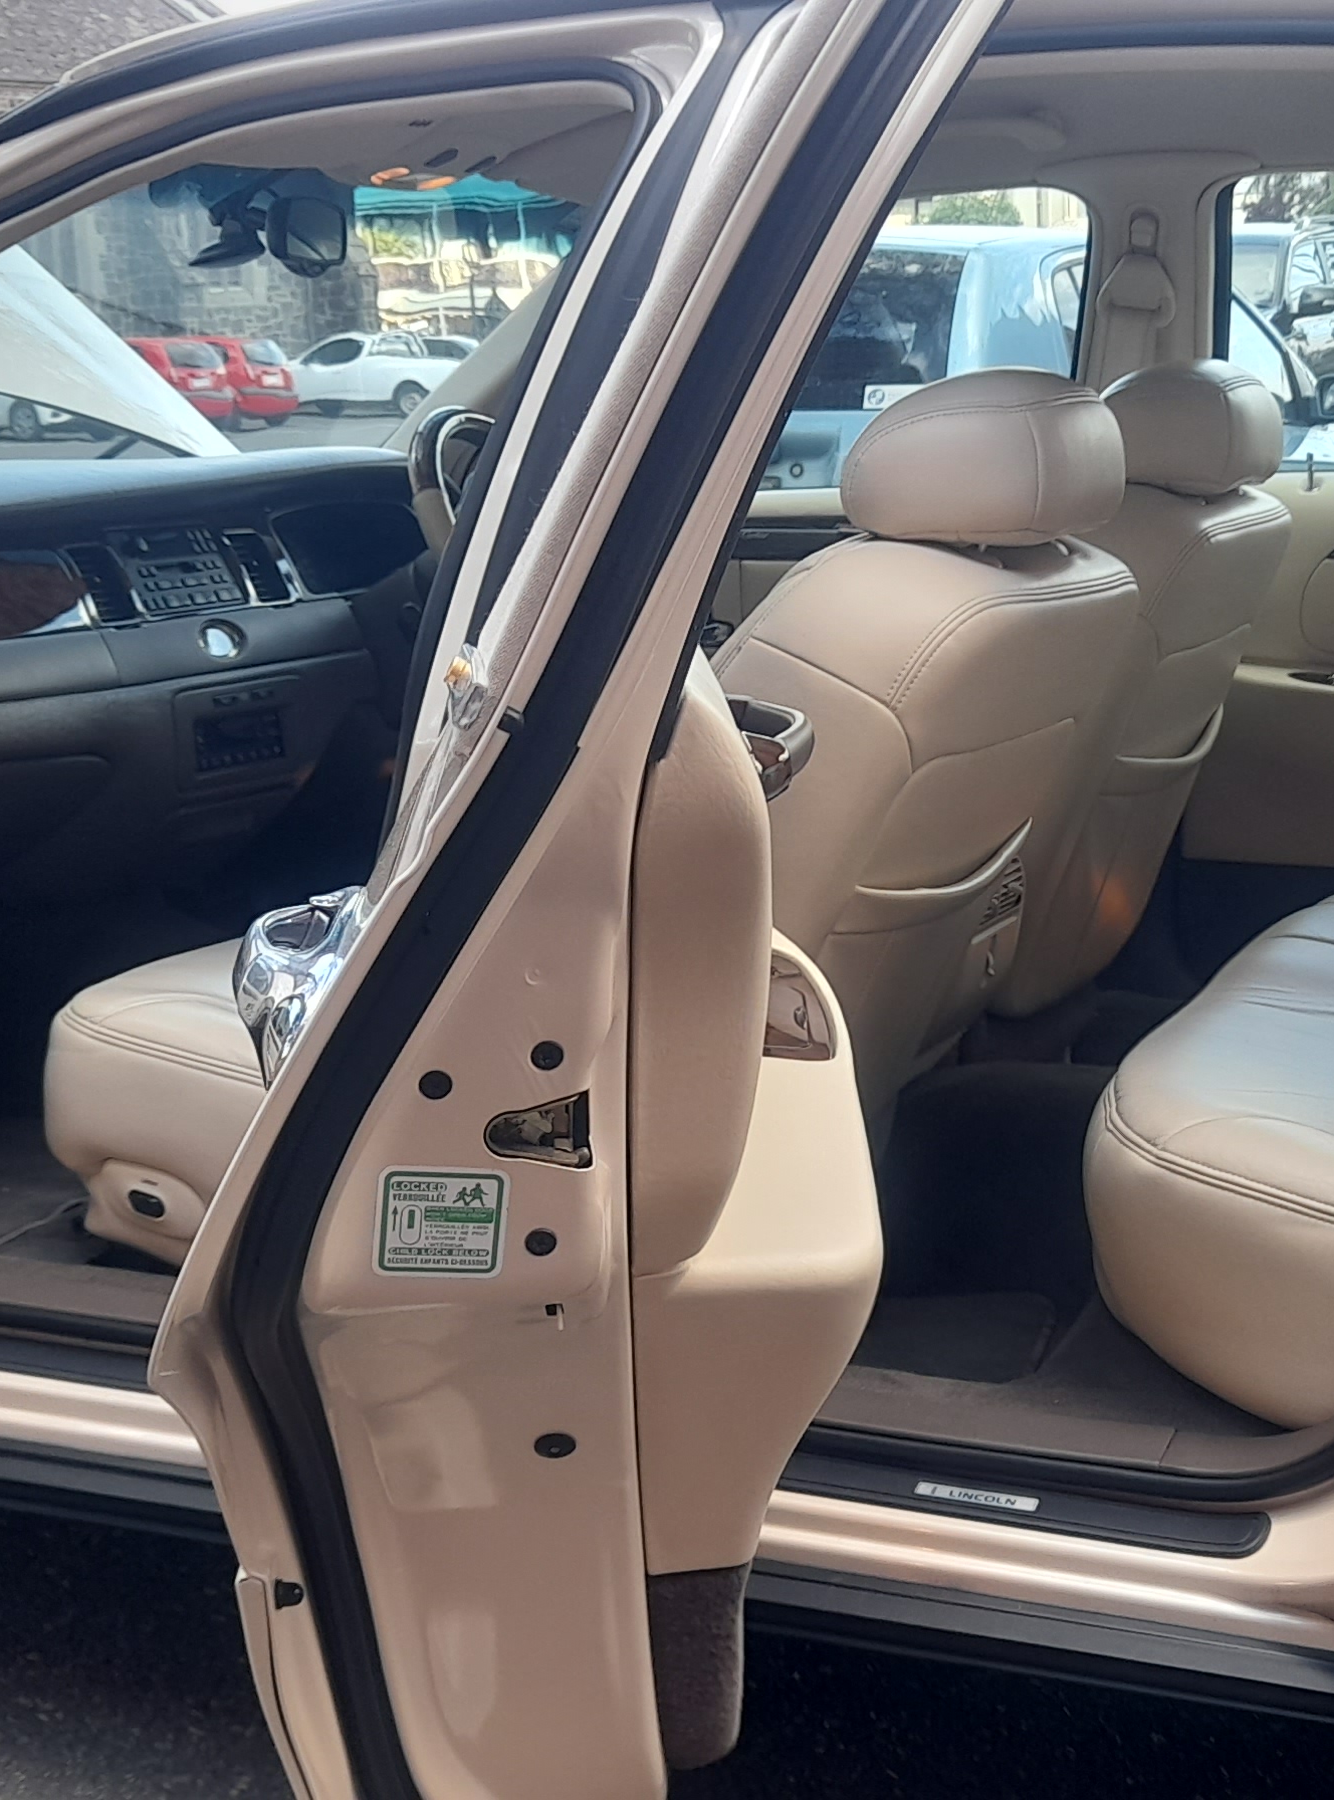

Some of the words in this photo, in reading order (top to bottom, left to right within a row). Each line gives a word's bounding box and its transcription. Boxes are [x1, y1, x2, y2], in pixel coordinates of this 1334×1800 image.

[393, 1182, 446, 1192] LOCKED
[421, 1248, 449, 1256] LOCK
[949, 1490, 1017, 1506] LINCOLN
